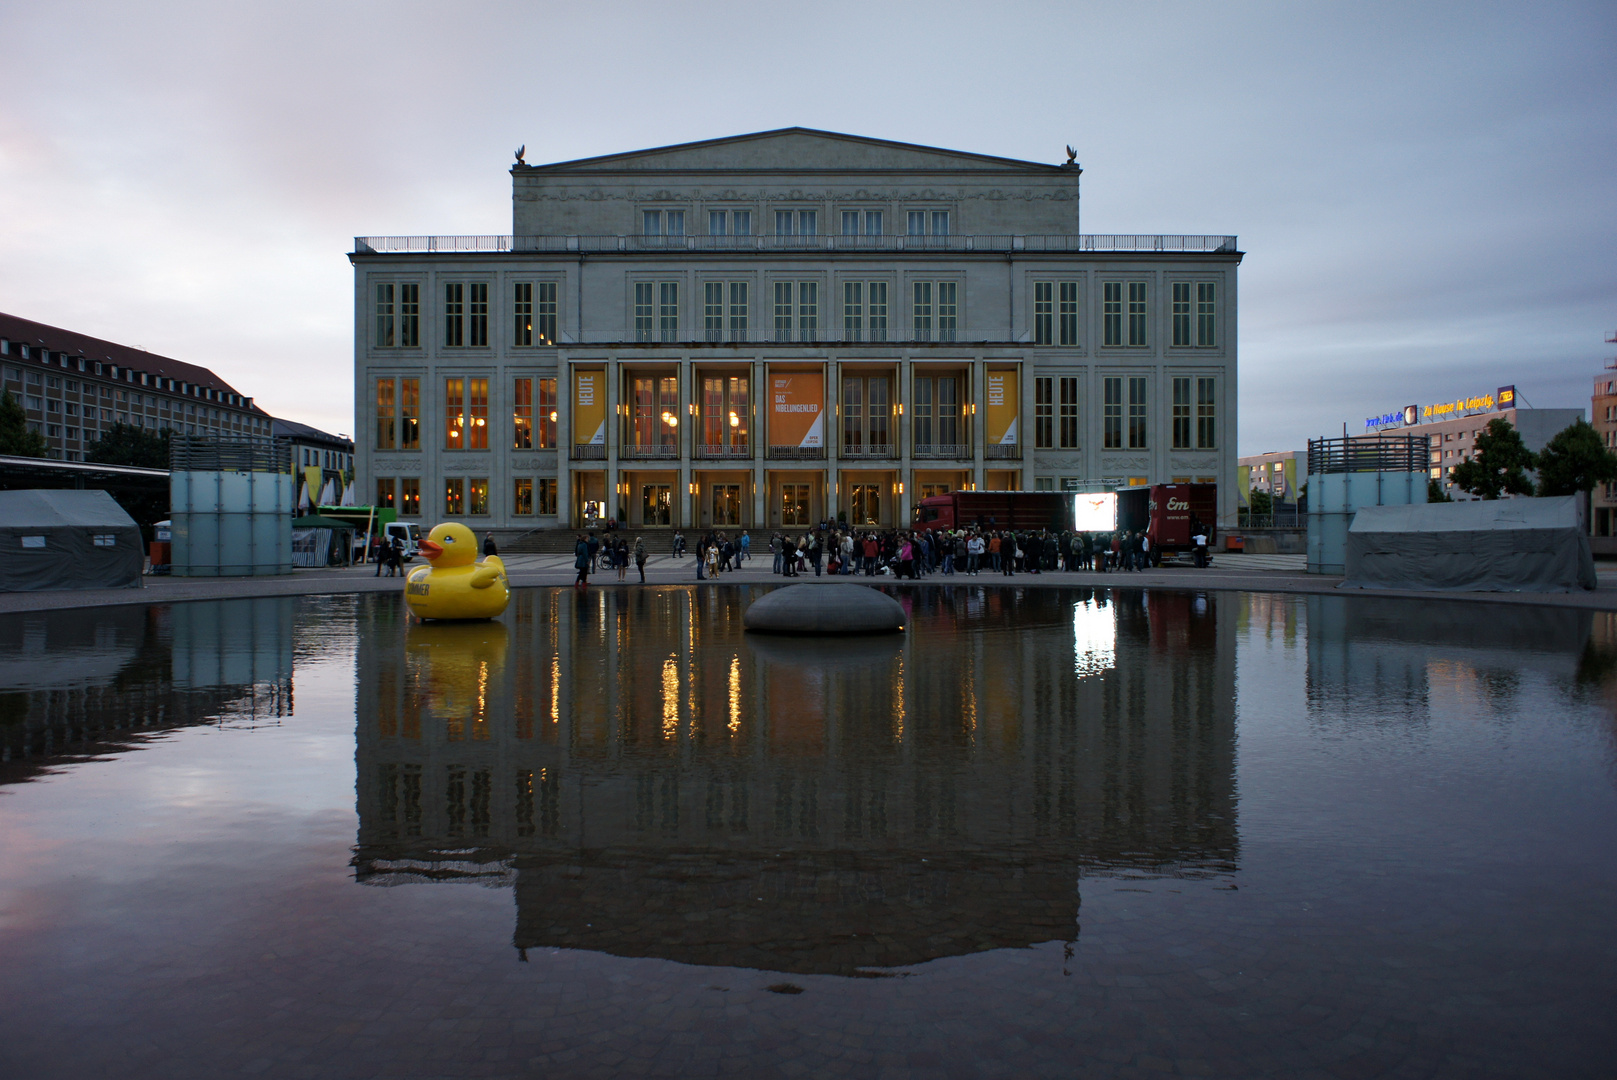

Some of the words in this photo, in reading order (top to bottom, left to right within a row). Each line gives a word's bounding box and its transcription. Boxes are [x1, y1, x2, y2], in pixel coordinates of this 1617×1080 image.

[578, 375, 594, 406] HEUTE
[775, 395, 786, 403] DAS
[988, 375, 1004, 406] HEUTE
[775, 404, 818, 413] NIBELUNGENLIED
[1423, 405, 1433, 417] Zu
[1456, 399, 1465, 411] in
